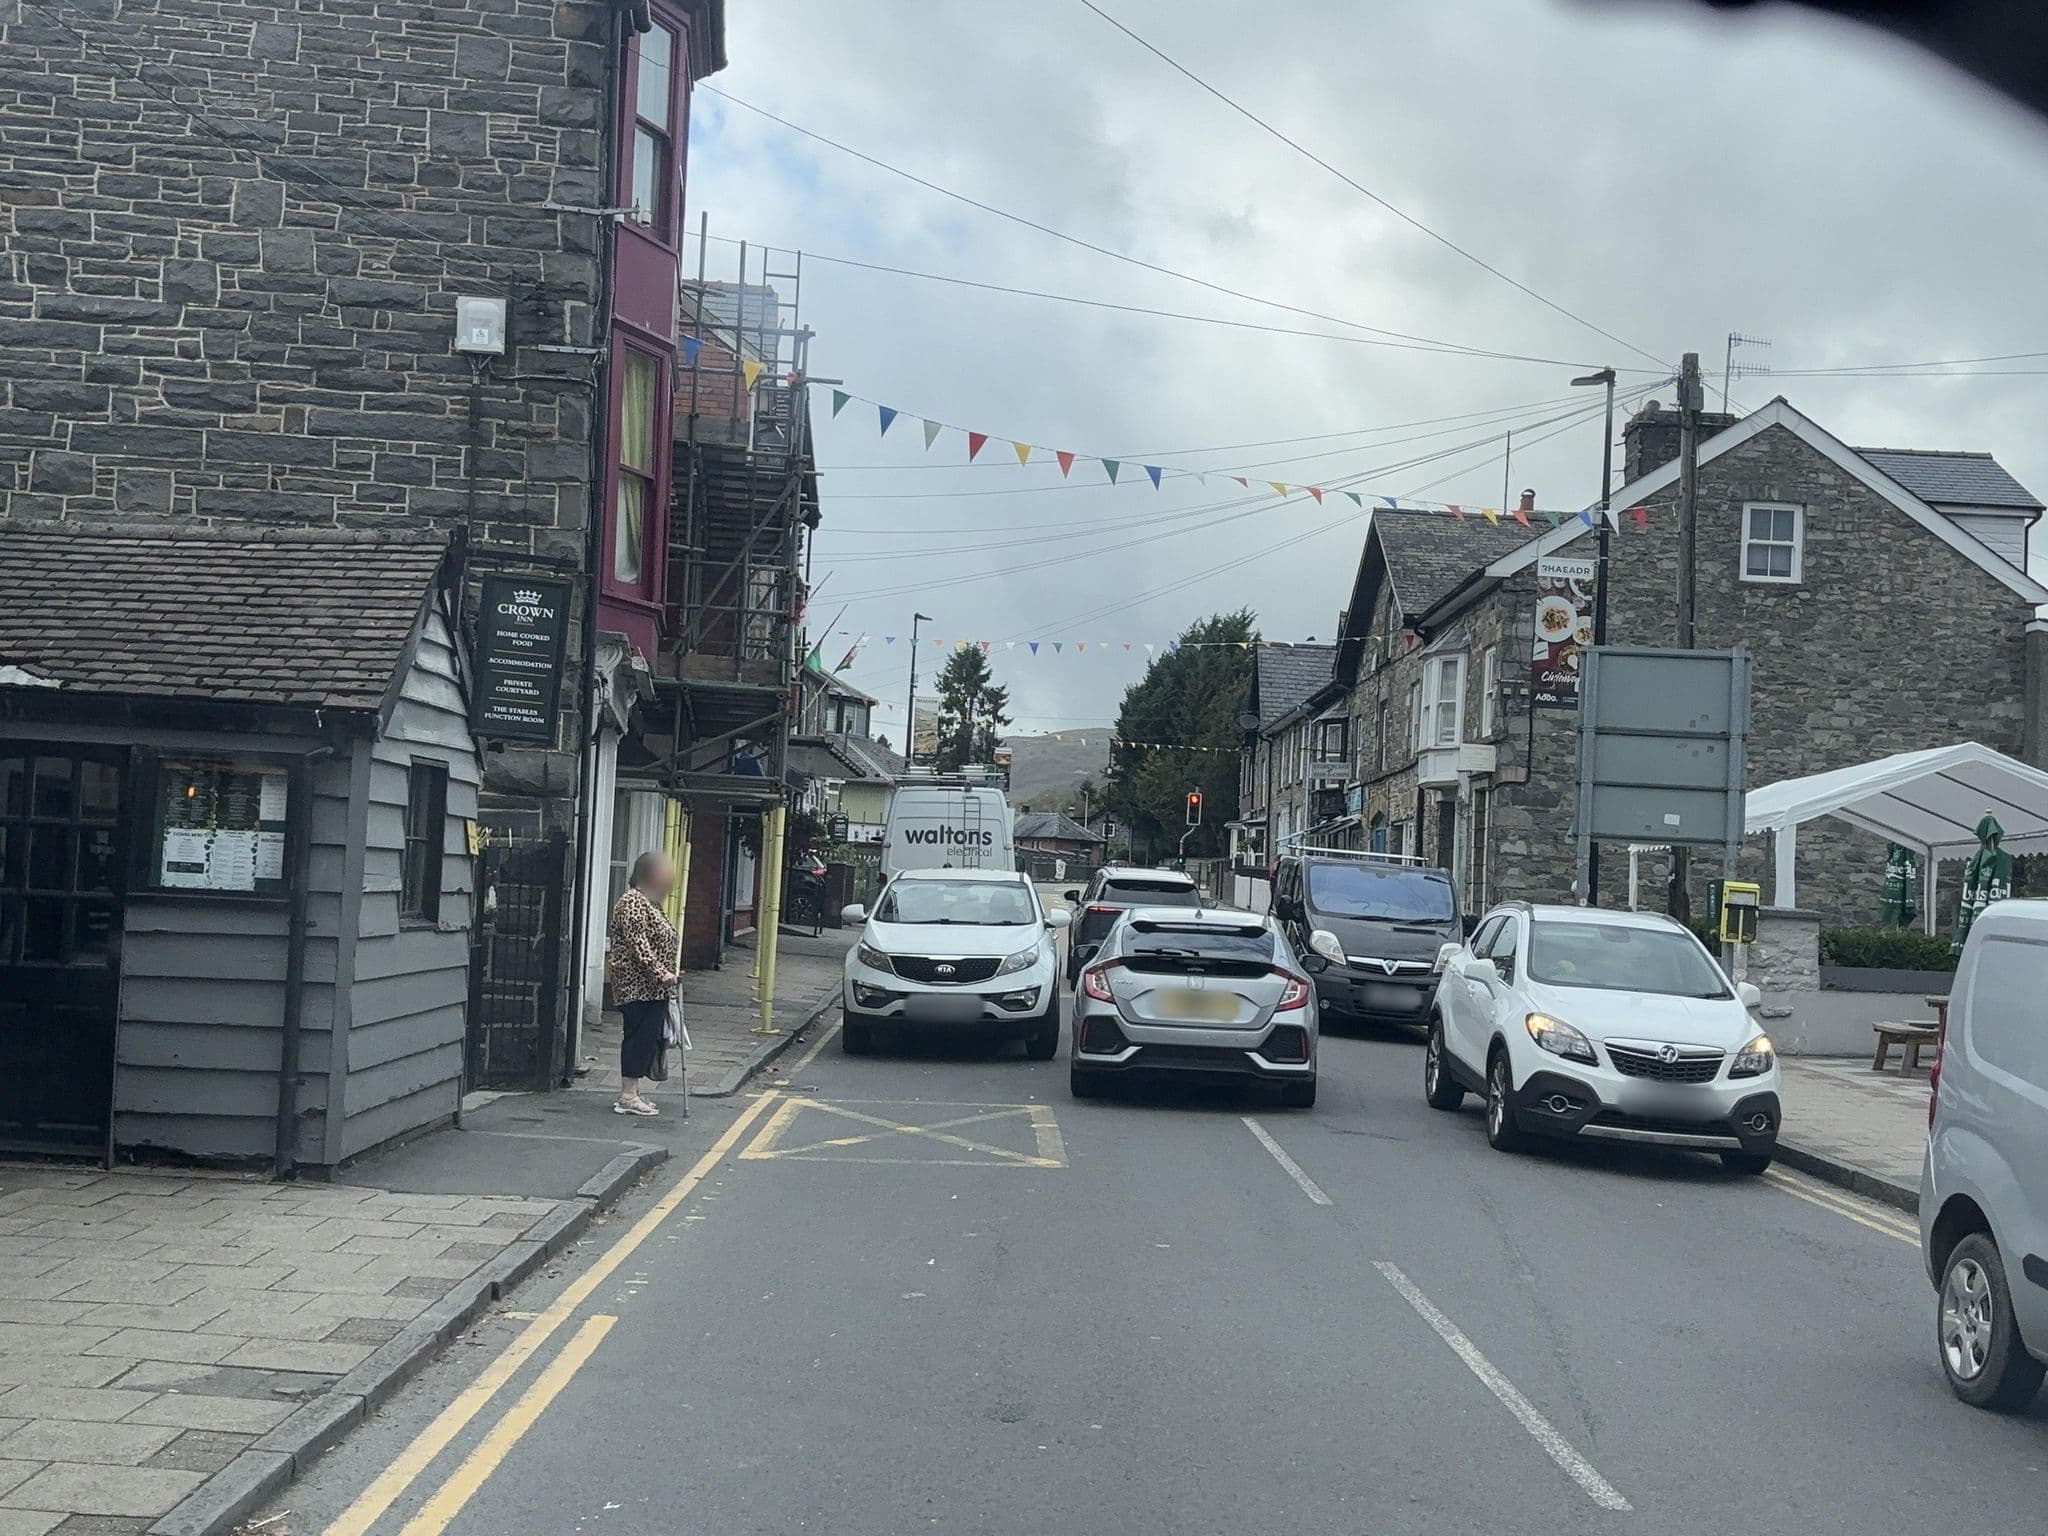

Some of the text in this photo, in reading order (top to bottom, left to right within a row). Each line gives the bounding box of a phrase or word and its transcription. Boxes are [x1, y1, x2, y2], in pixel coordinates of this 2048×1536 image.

[497, 603, 555, 619] CROWN
[516, 615, 534, 623] INN
[496, 630, 551, 641] HOME COOKED
[512, 639, 533, 647] FOOD
[488, 656, 553, 669] ACCOMMODATION
[503, 679, 533, 688] PRIVATE
[495, 686, 540, 696] COURTYARD
[492, 705, 538, 716] THE STABLES
[484, 712, 545, 724] FUNCTION ROOM
[905, 824, 993, 845] waltons
[946, 846, 993, 857] electrical
